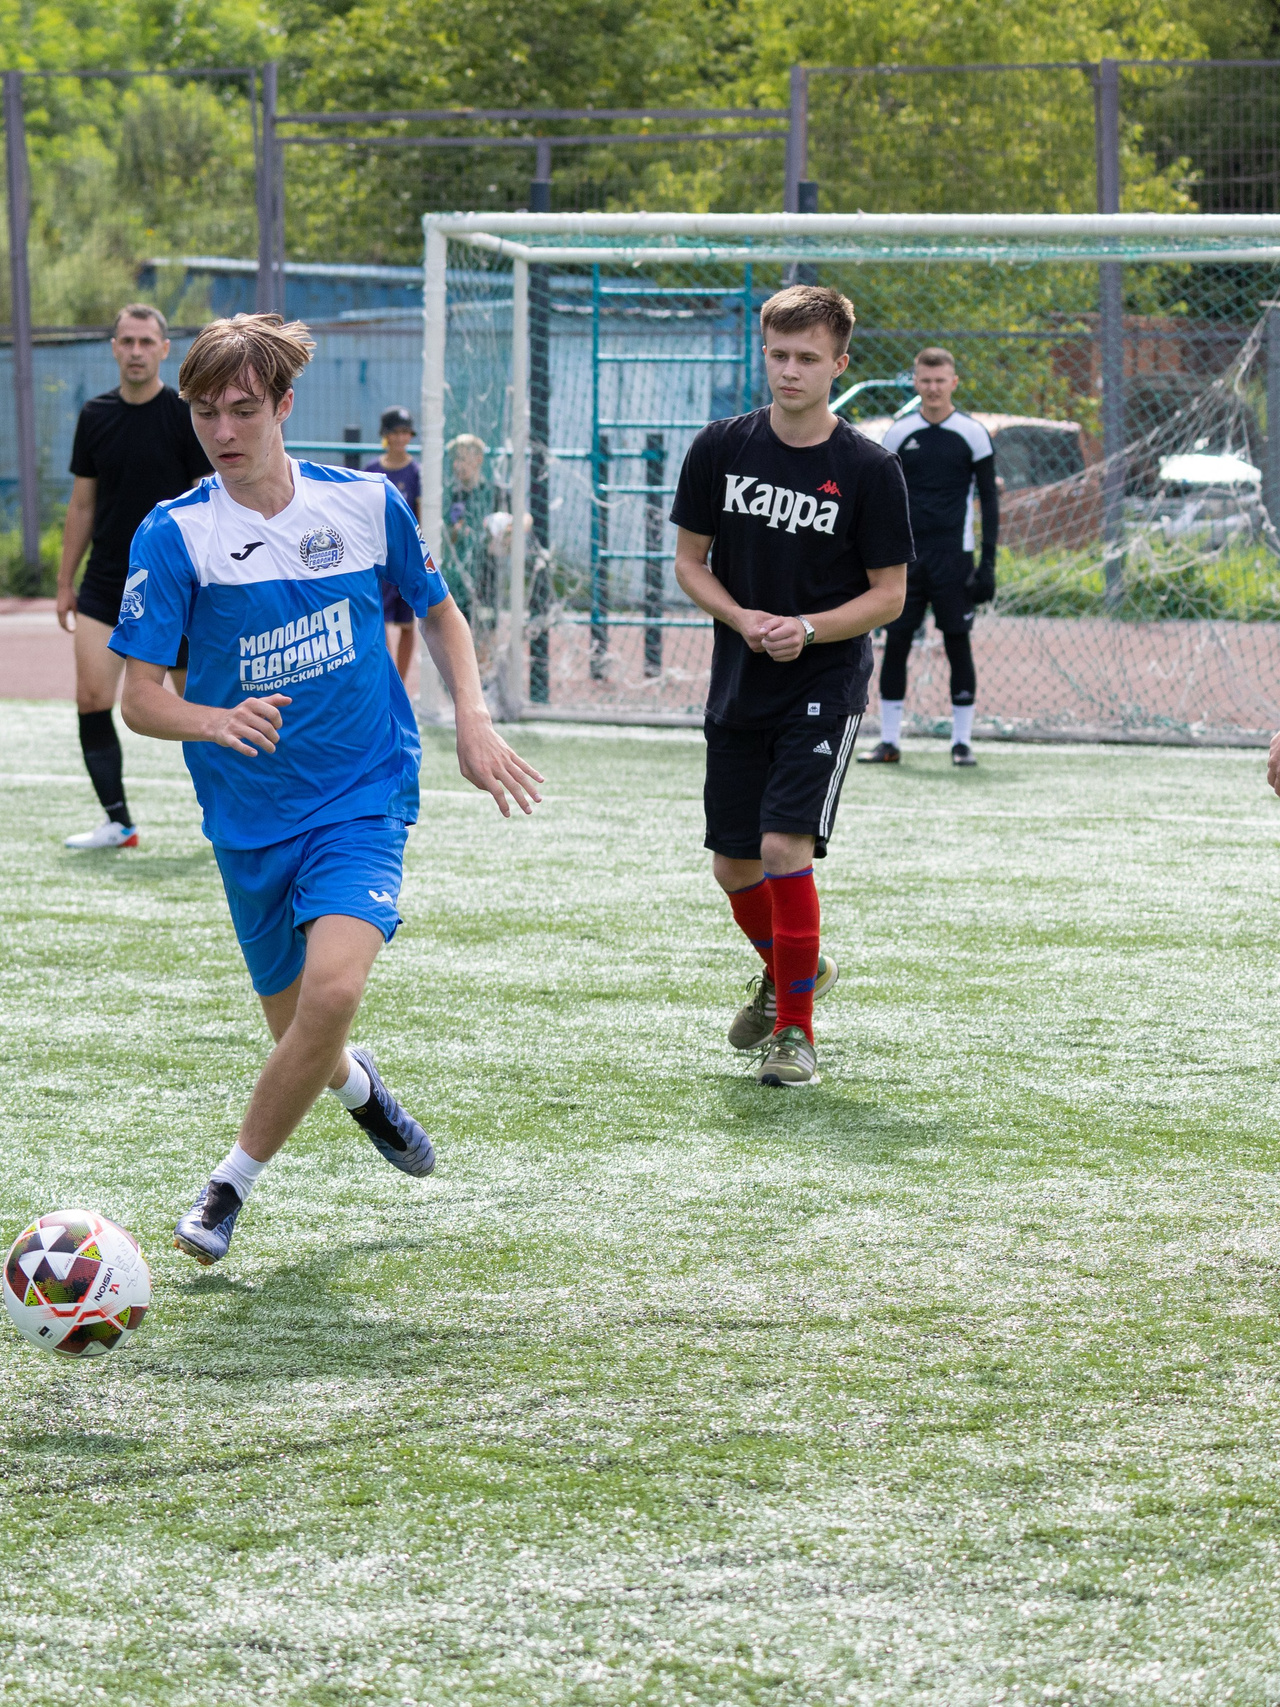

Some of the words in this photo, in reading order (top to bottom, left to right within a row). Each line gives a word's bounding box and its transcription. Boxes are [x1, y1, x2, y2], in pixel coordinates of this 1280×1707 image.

[722, 474, 839, 535] Kappa
[239, 598, 353, 657] МОЛОДАЯ
[239, 630, 353, 681] ГВАРДИЯ
[241, 664, 323, 691] ПРИМОРСКИЙ
[327, 648, 356, 672] КРАЙ
[94, 1267, 114, 1301] VISION
